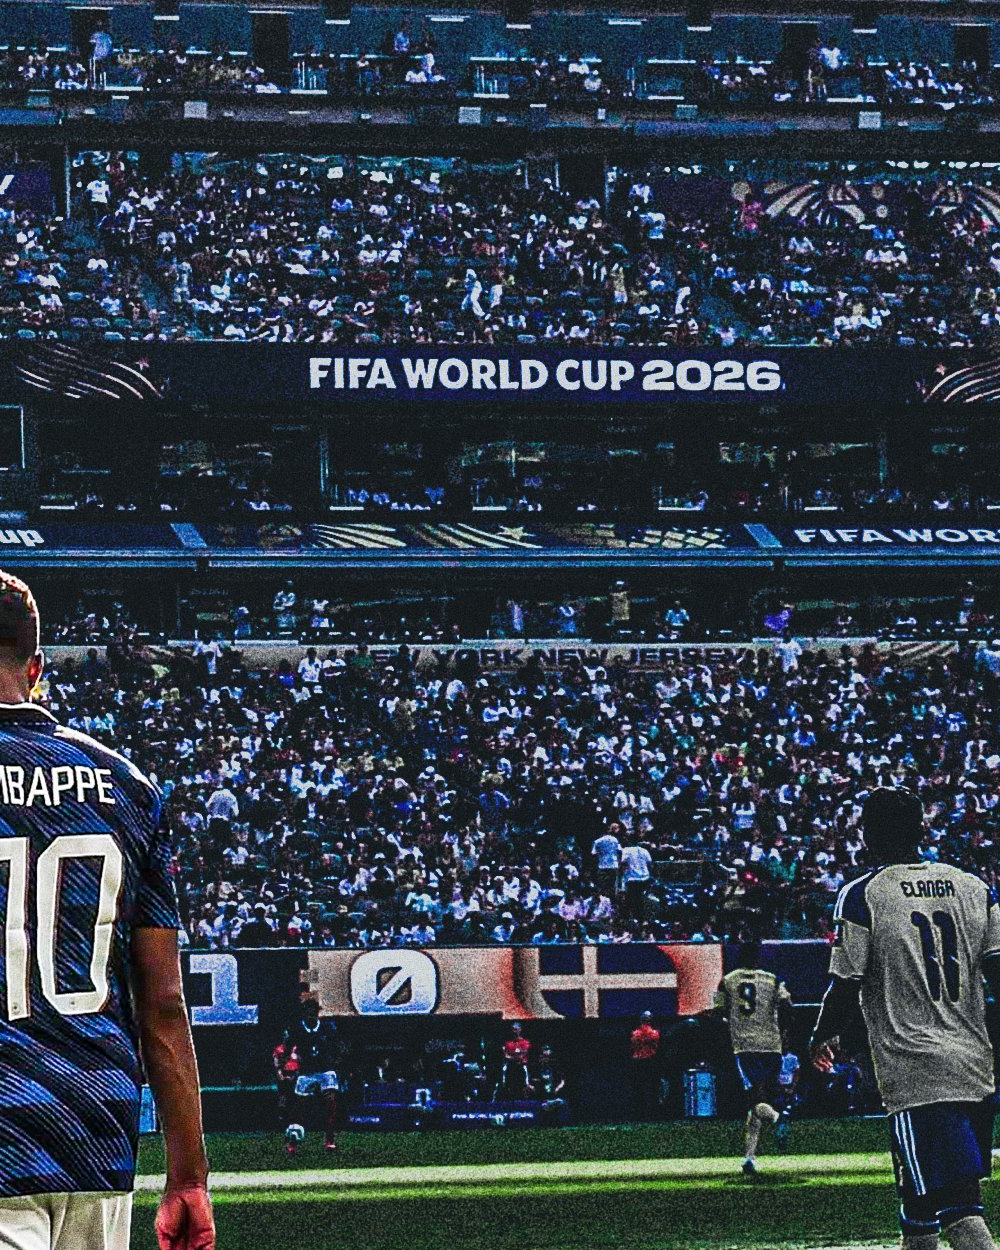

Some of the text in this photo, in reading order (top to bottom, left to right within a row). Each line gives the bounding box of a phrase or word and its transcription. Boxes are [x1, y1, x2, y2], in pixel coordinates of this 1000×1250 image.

[309, 357, 782, 391] FIFA WORLD CUP 2026
[793, 528, 894, 543] FIFA
[900, 879, 955, 898] ELANGA
[910, 910, 960, 1003] 11
[189, 953, 259, 1025] 1
